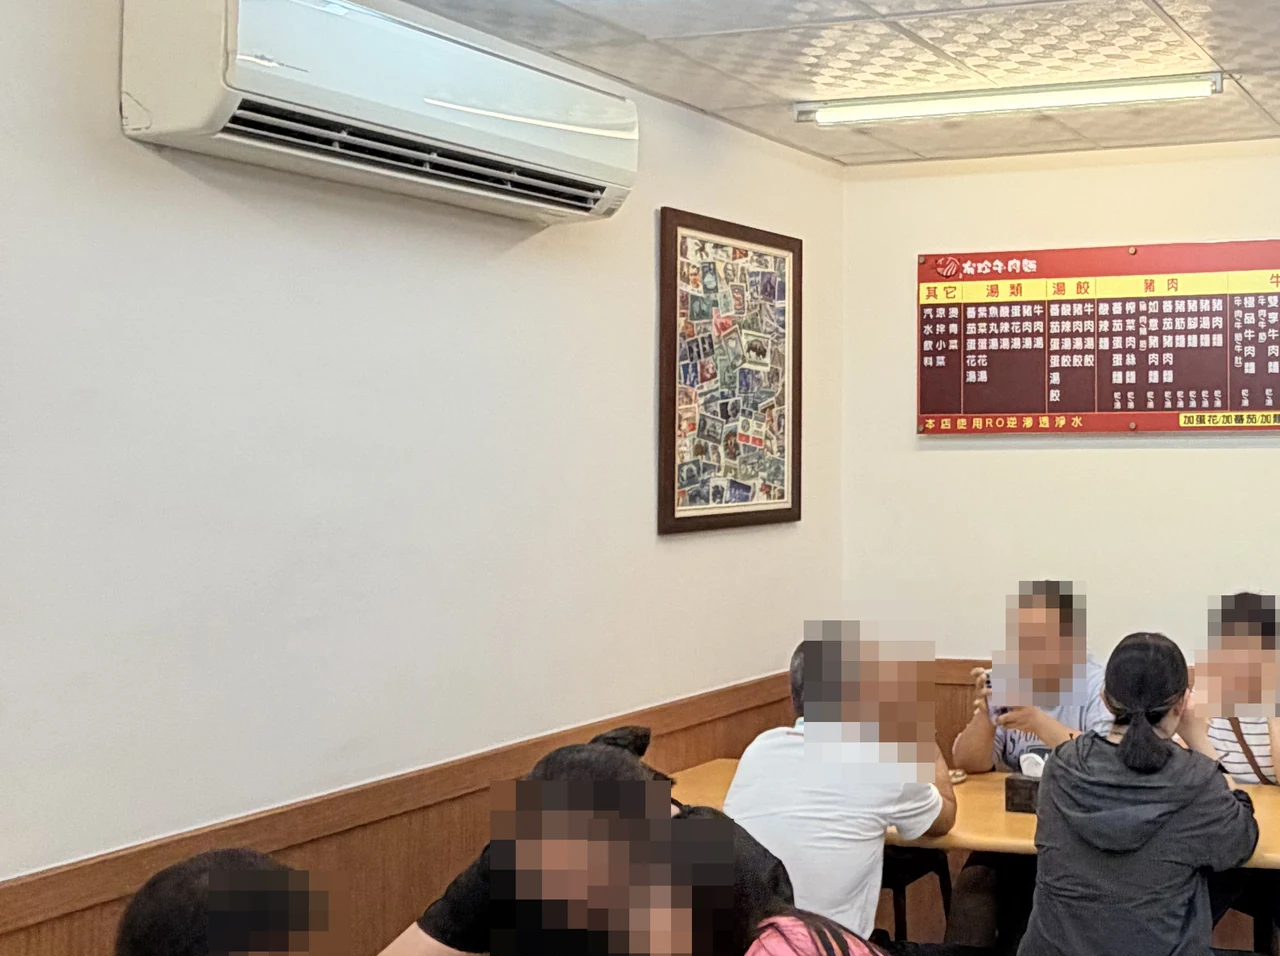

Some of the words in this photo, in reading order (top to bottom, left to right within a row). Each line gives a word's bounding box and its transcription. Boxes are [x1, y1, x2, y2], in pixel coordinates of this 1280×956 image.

[986, 284, 1023, 298] 湯類
[1052, 282, 1090, 295] 湯餃
[1144, 278, 1178, 293] 豬肉
[926, 287, 957, 300] 其它
[1033, 305, 1044, 349] 牛肉湯
